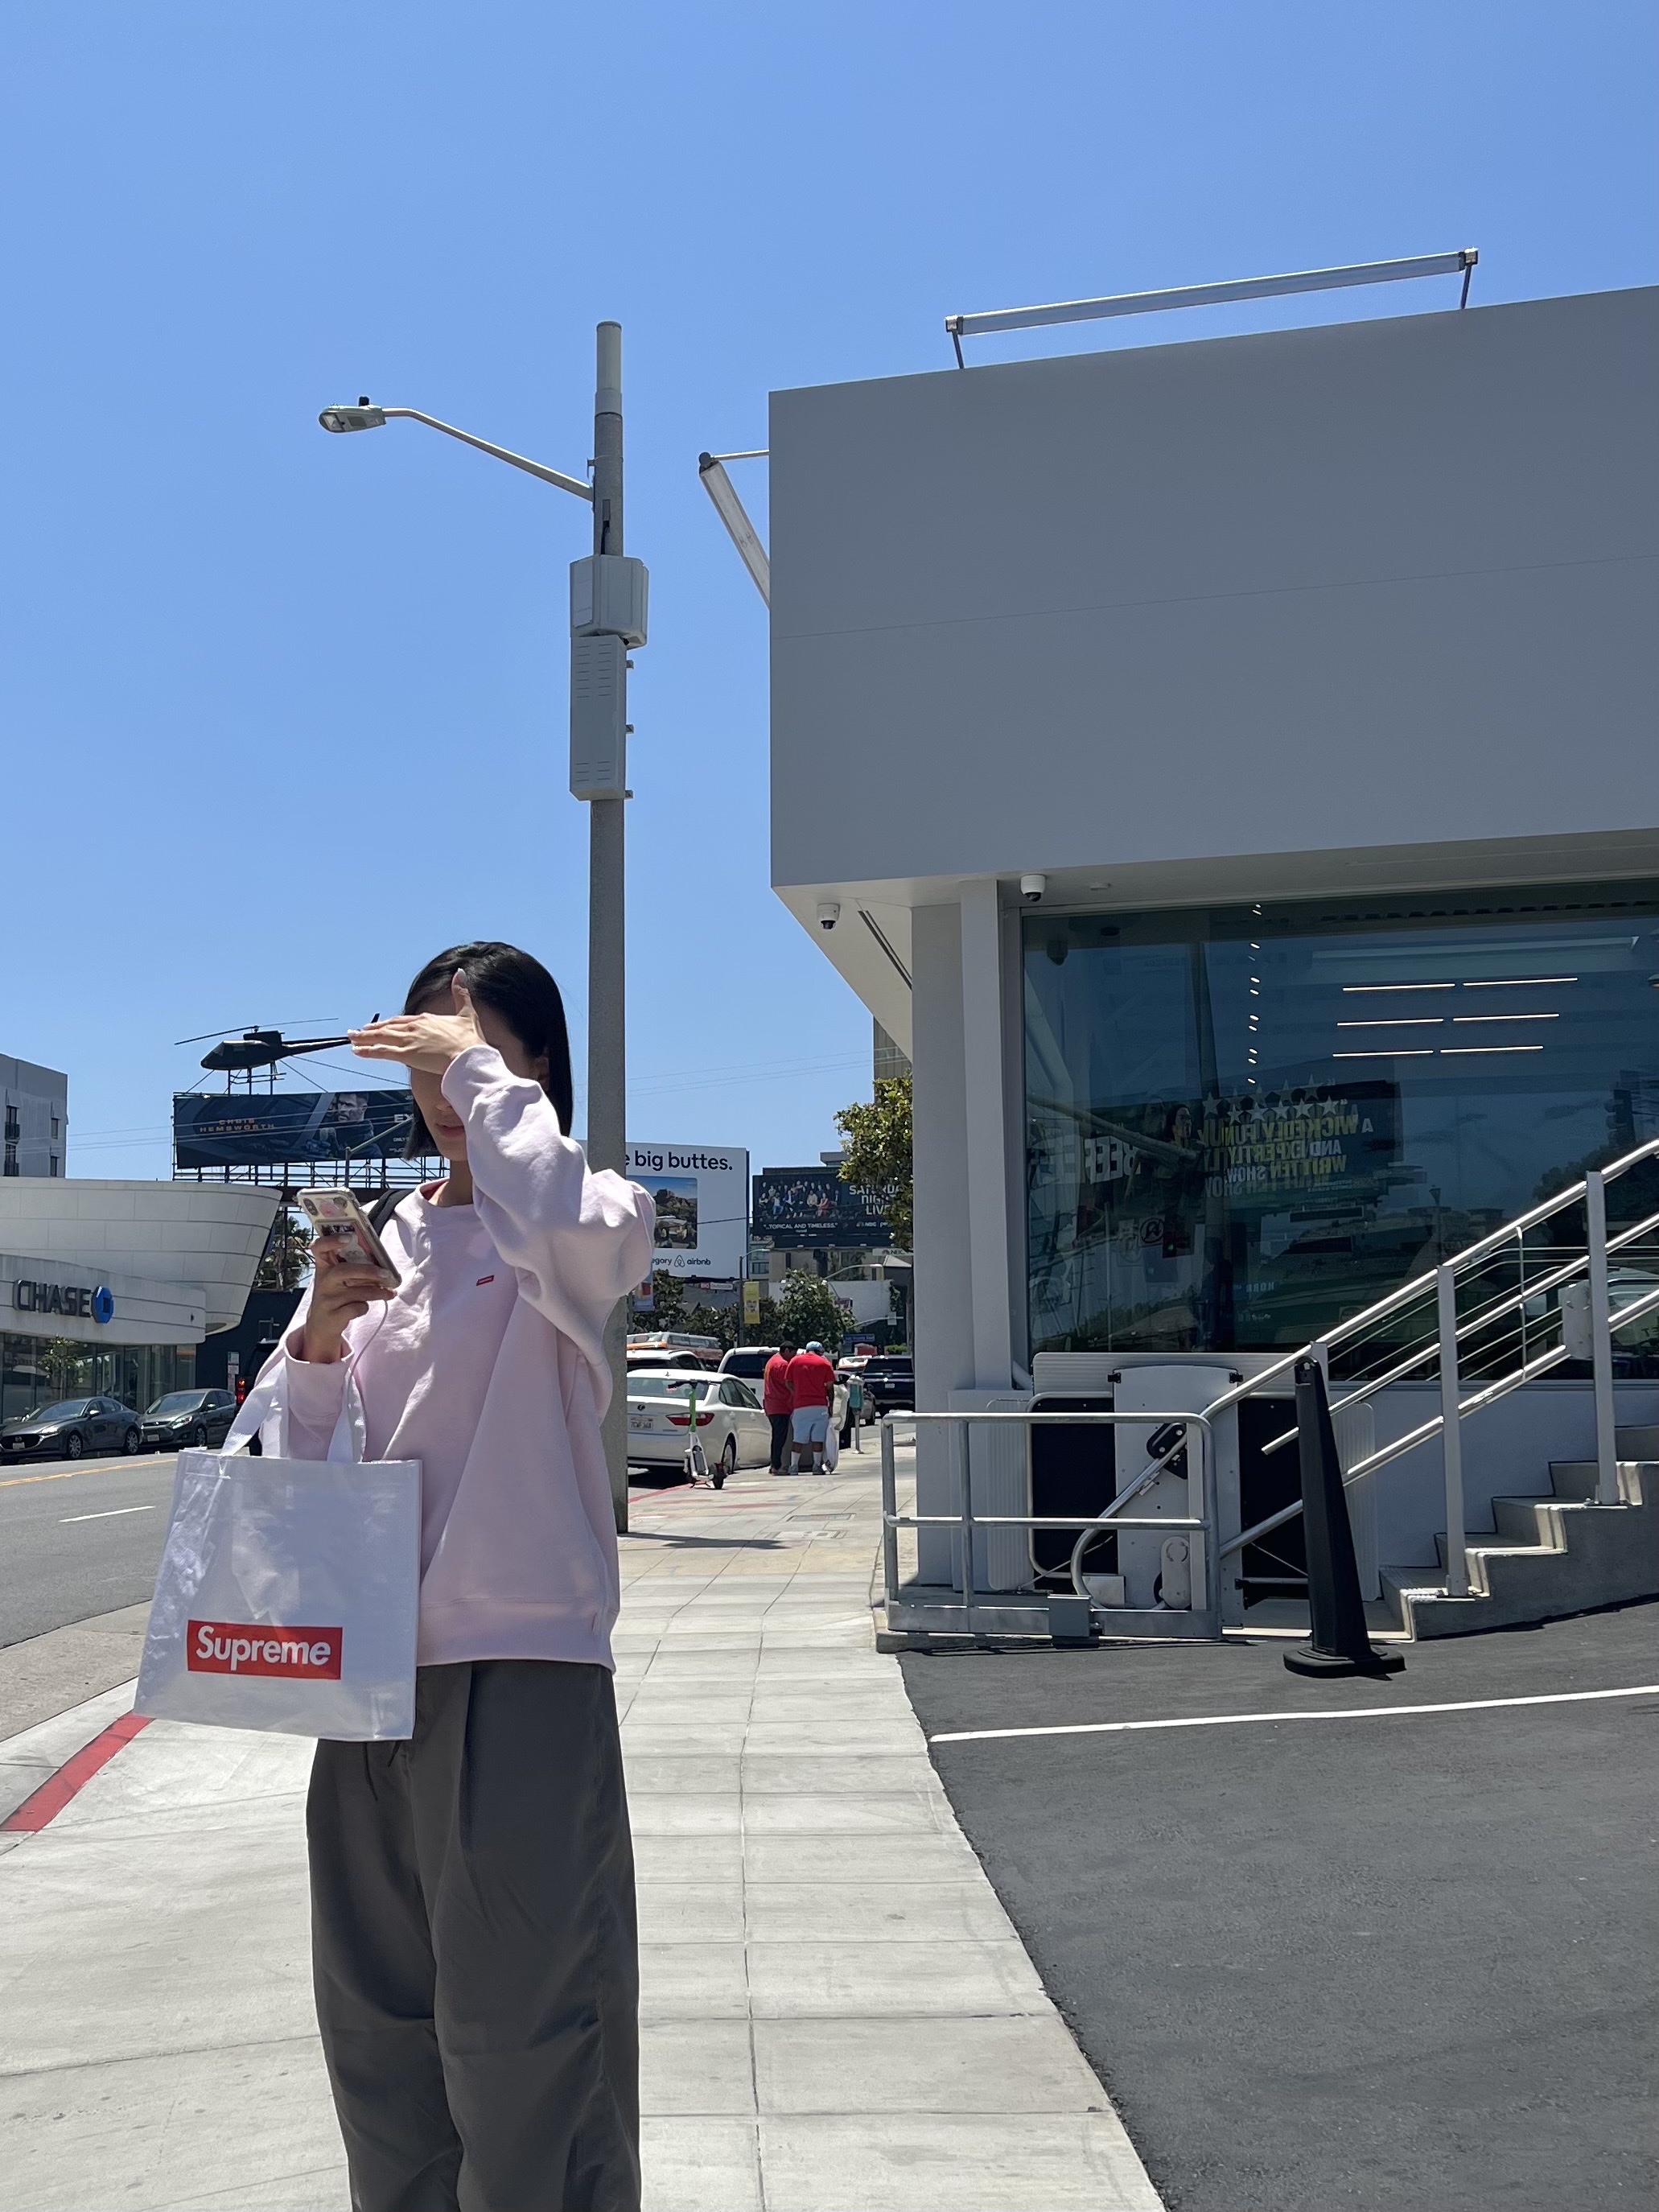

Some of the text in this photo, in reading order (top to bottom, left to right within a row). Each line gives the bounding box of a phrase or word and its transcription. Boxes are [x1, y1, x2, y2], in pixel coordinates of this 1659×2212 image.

[635, 1151, 664, 1172] big
[669, 1151, 733, 1171] buttes.
[687, 1258, 711, 1266] airbnb
[13, 1279, 92, 1318] CHASE
[196, 1625, 331, 1671] Supreme
